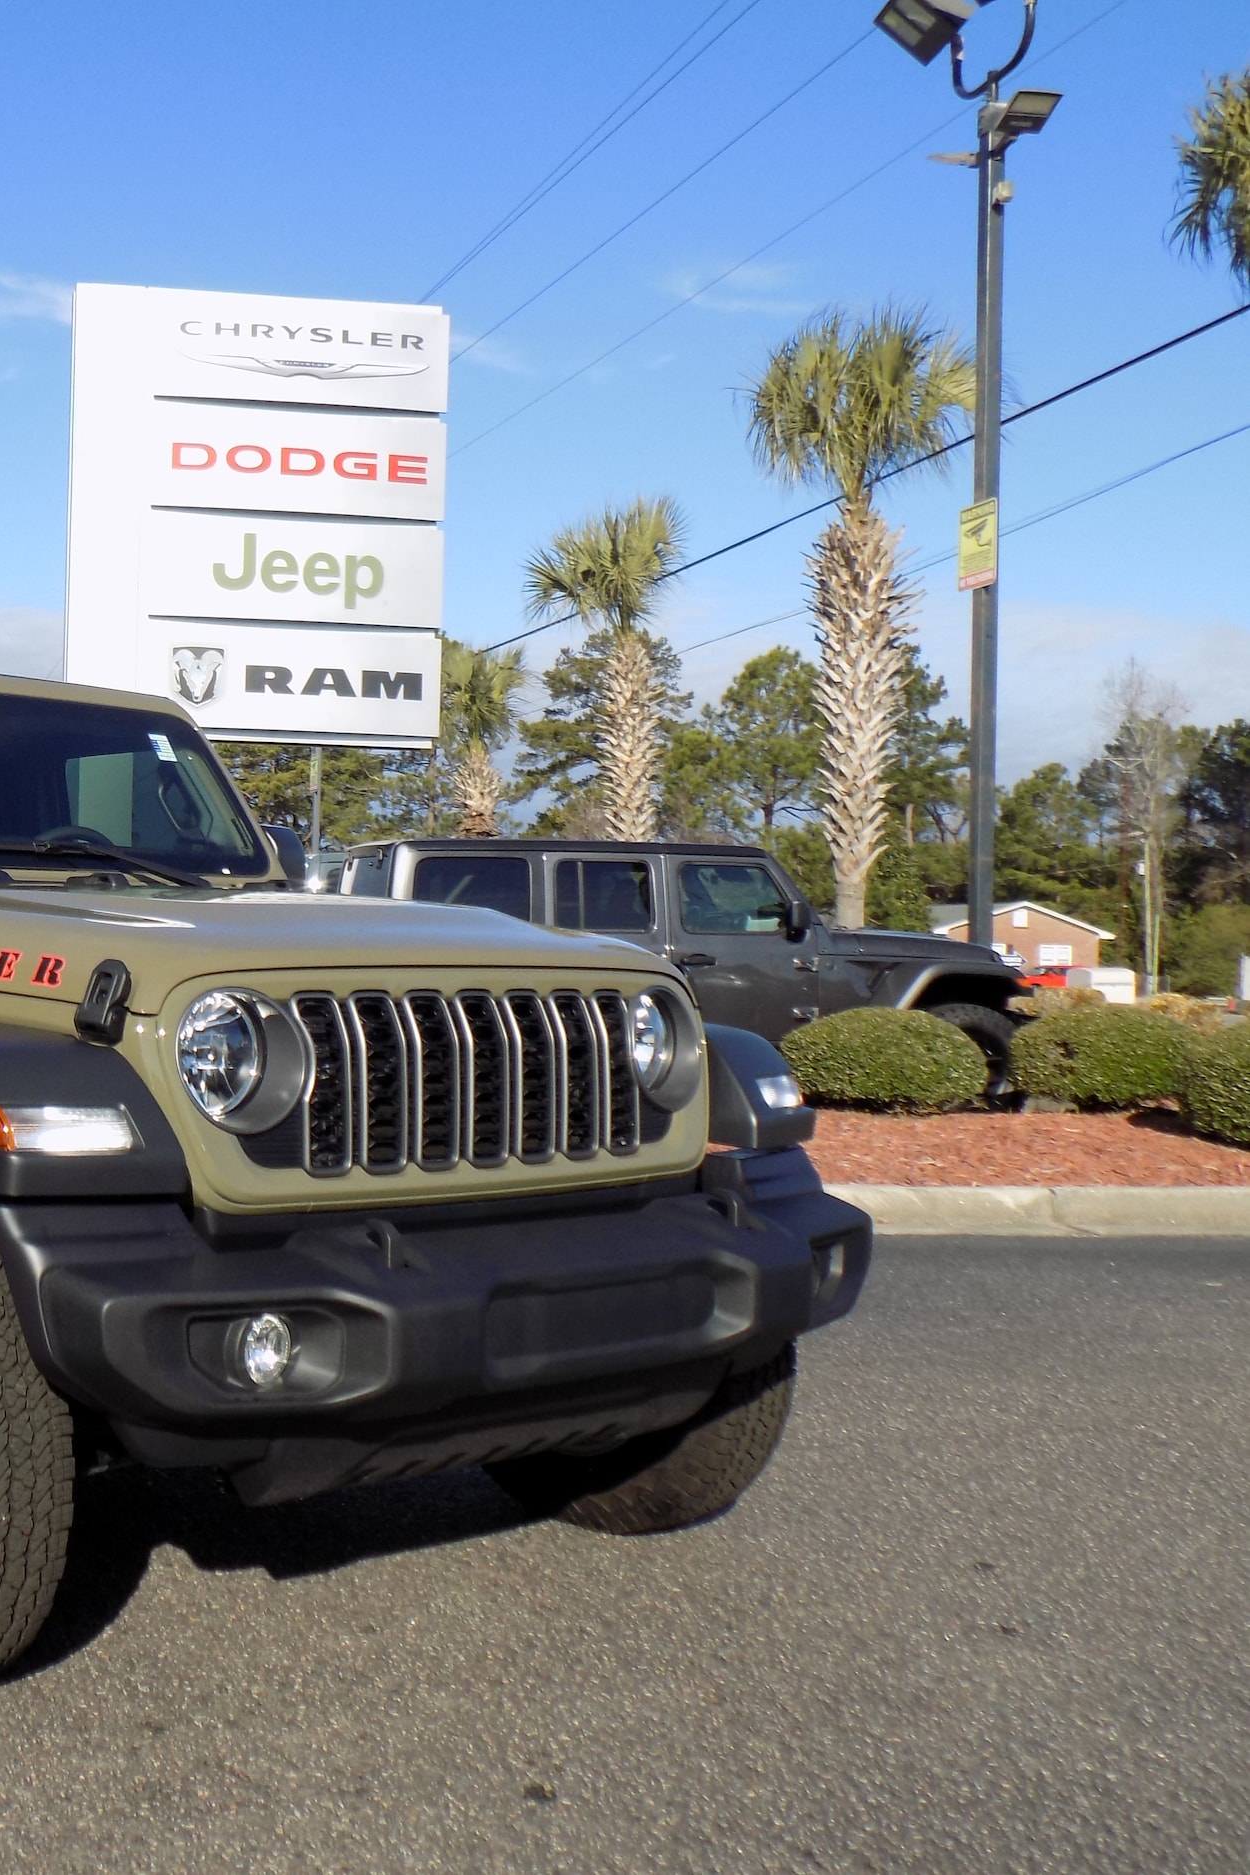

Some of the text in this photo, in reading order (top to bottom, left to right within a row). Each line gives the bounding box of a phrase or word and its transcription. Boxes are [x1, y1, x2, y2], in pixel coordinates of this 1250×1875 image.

[180, 320, 424, 351] CHRYSLER
[171, 442, 428, 485] DODGE
[212, 533, 385, 610] Jeep
[245, 664, 423, 701] RAM
